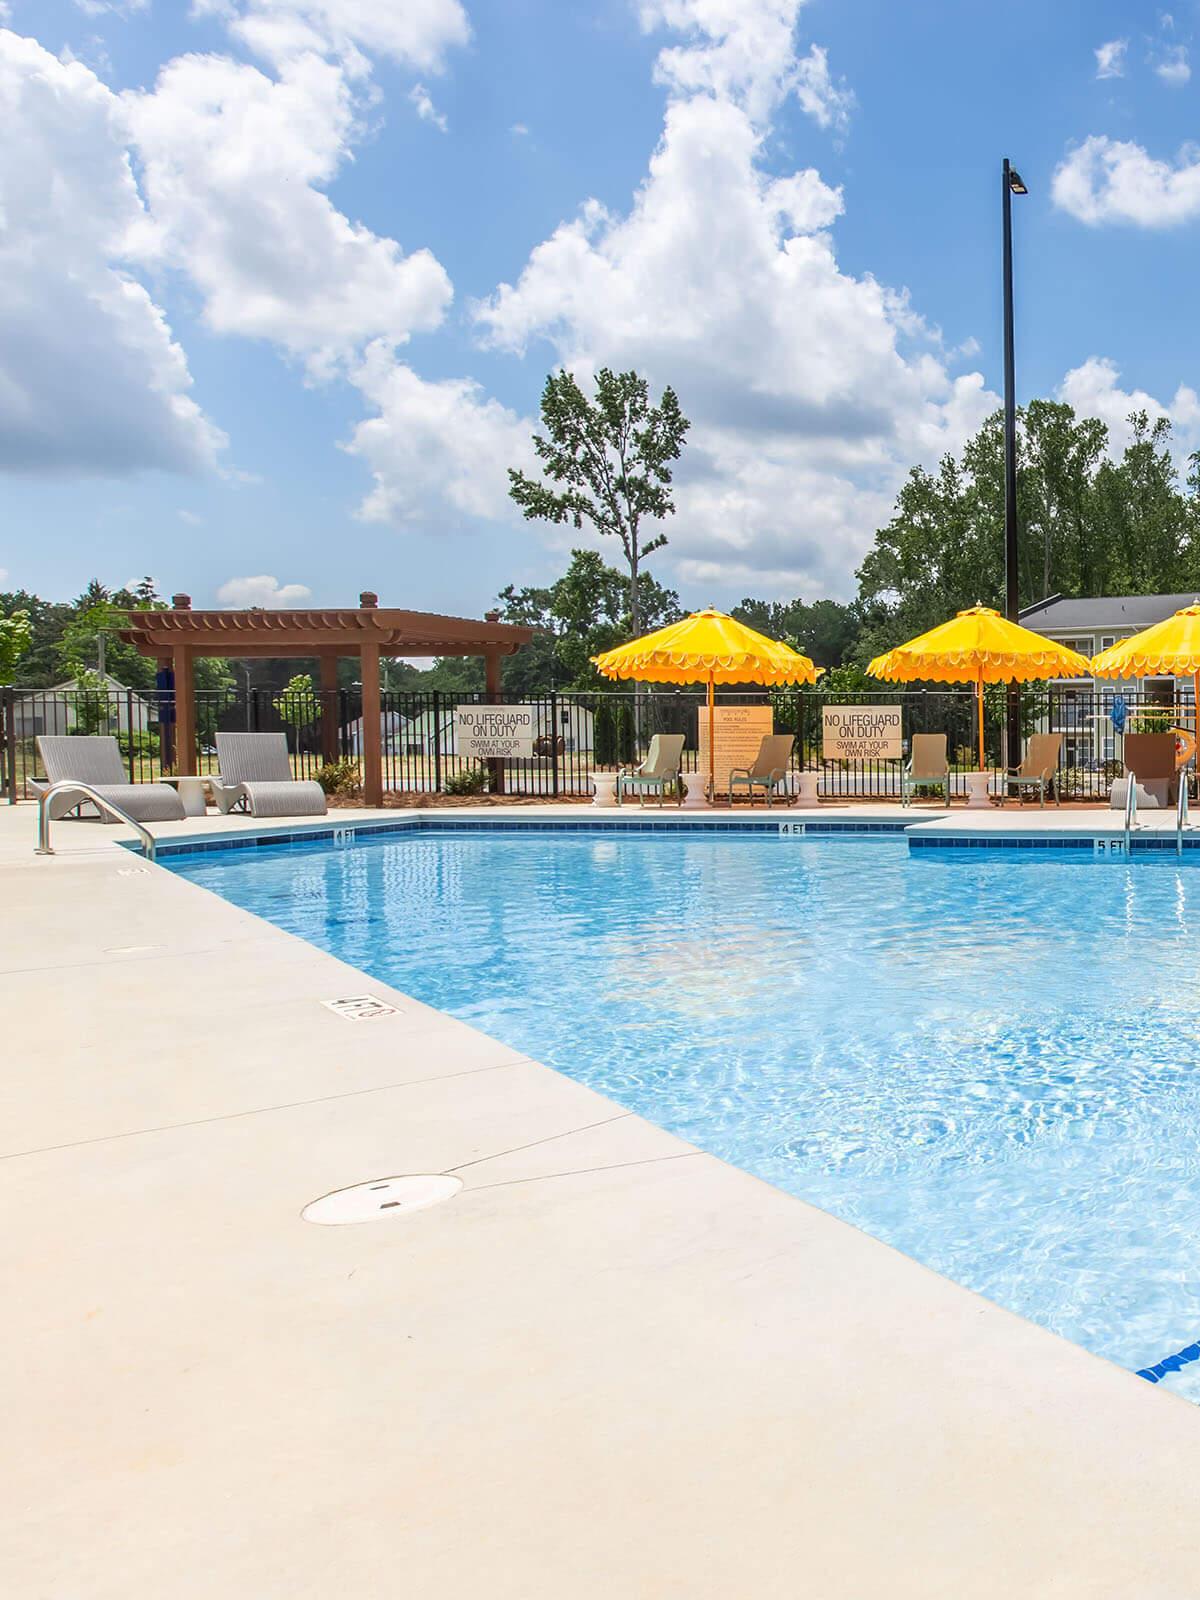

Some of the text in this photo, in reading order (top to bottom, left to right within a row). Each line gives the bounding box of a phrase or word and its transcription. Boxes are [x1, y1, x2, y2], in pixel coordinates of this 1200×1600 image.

[459, 713, 530, 726] NO LIFEGUARD
[824, 714, 900, 727] NO LIFEGUARD
[472, 725, 517, 737] ON DUTY
[839, 726, 885, 738] ON DUTY
[470, 740, 520, 749] SWIM AT YOUR
[836, 741, 889, 750] SWIM AT YOUR
[478, 748, 513, 756] OWN RISK
[845, 749, 881, 757] OWN RISK
[782, 824, 804, 834] 4 FT
[1110, 840, 1124, 855] FT
